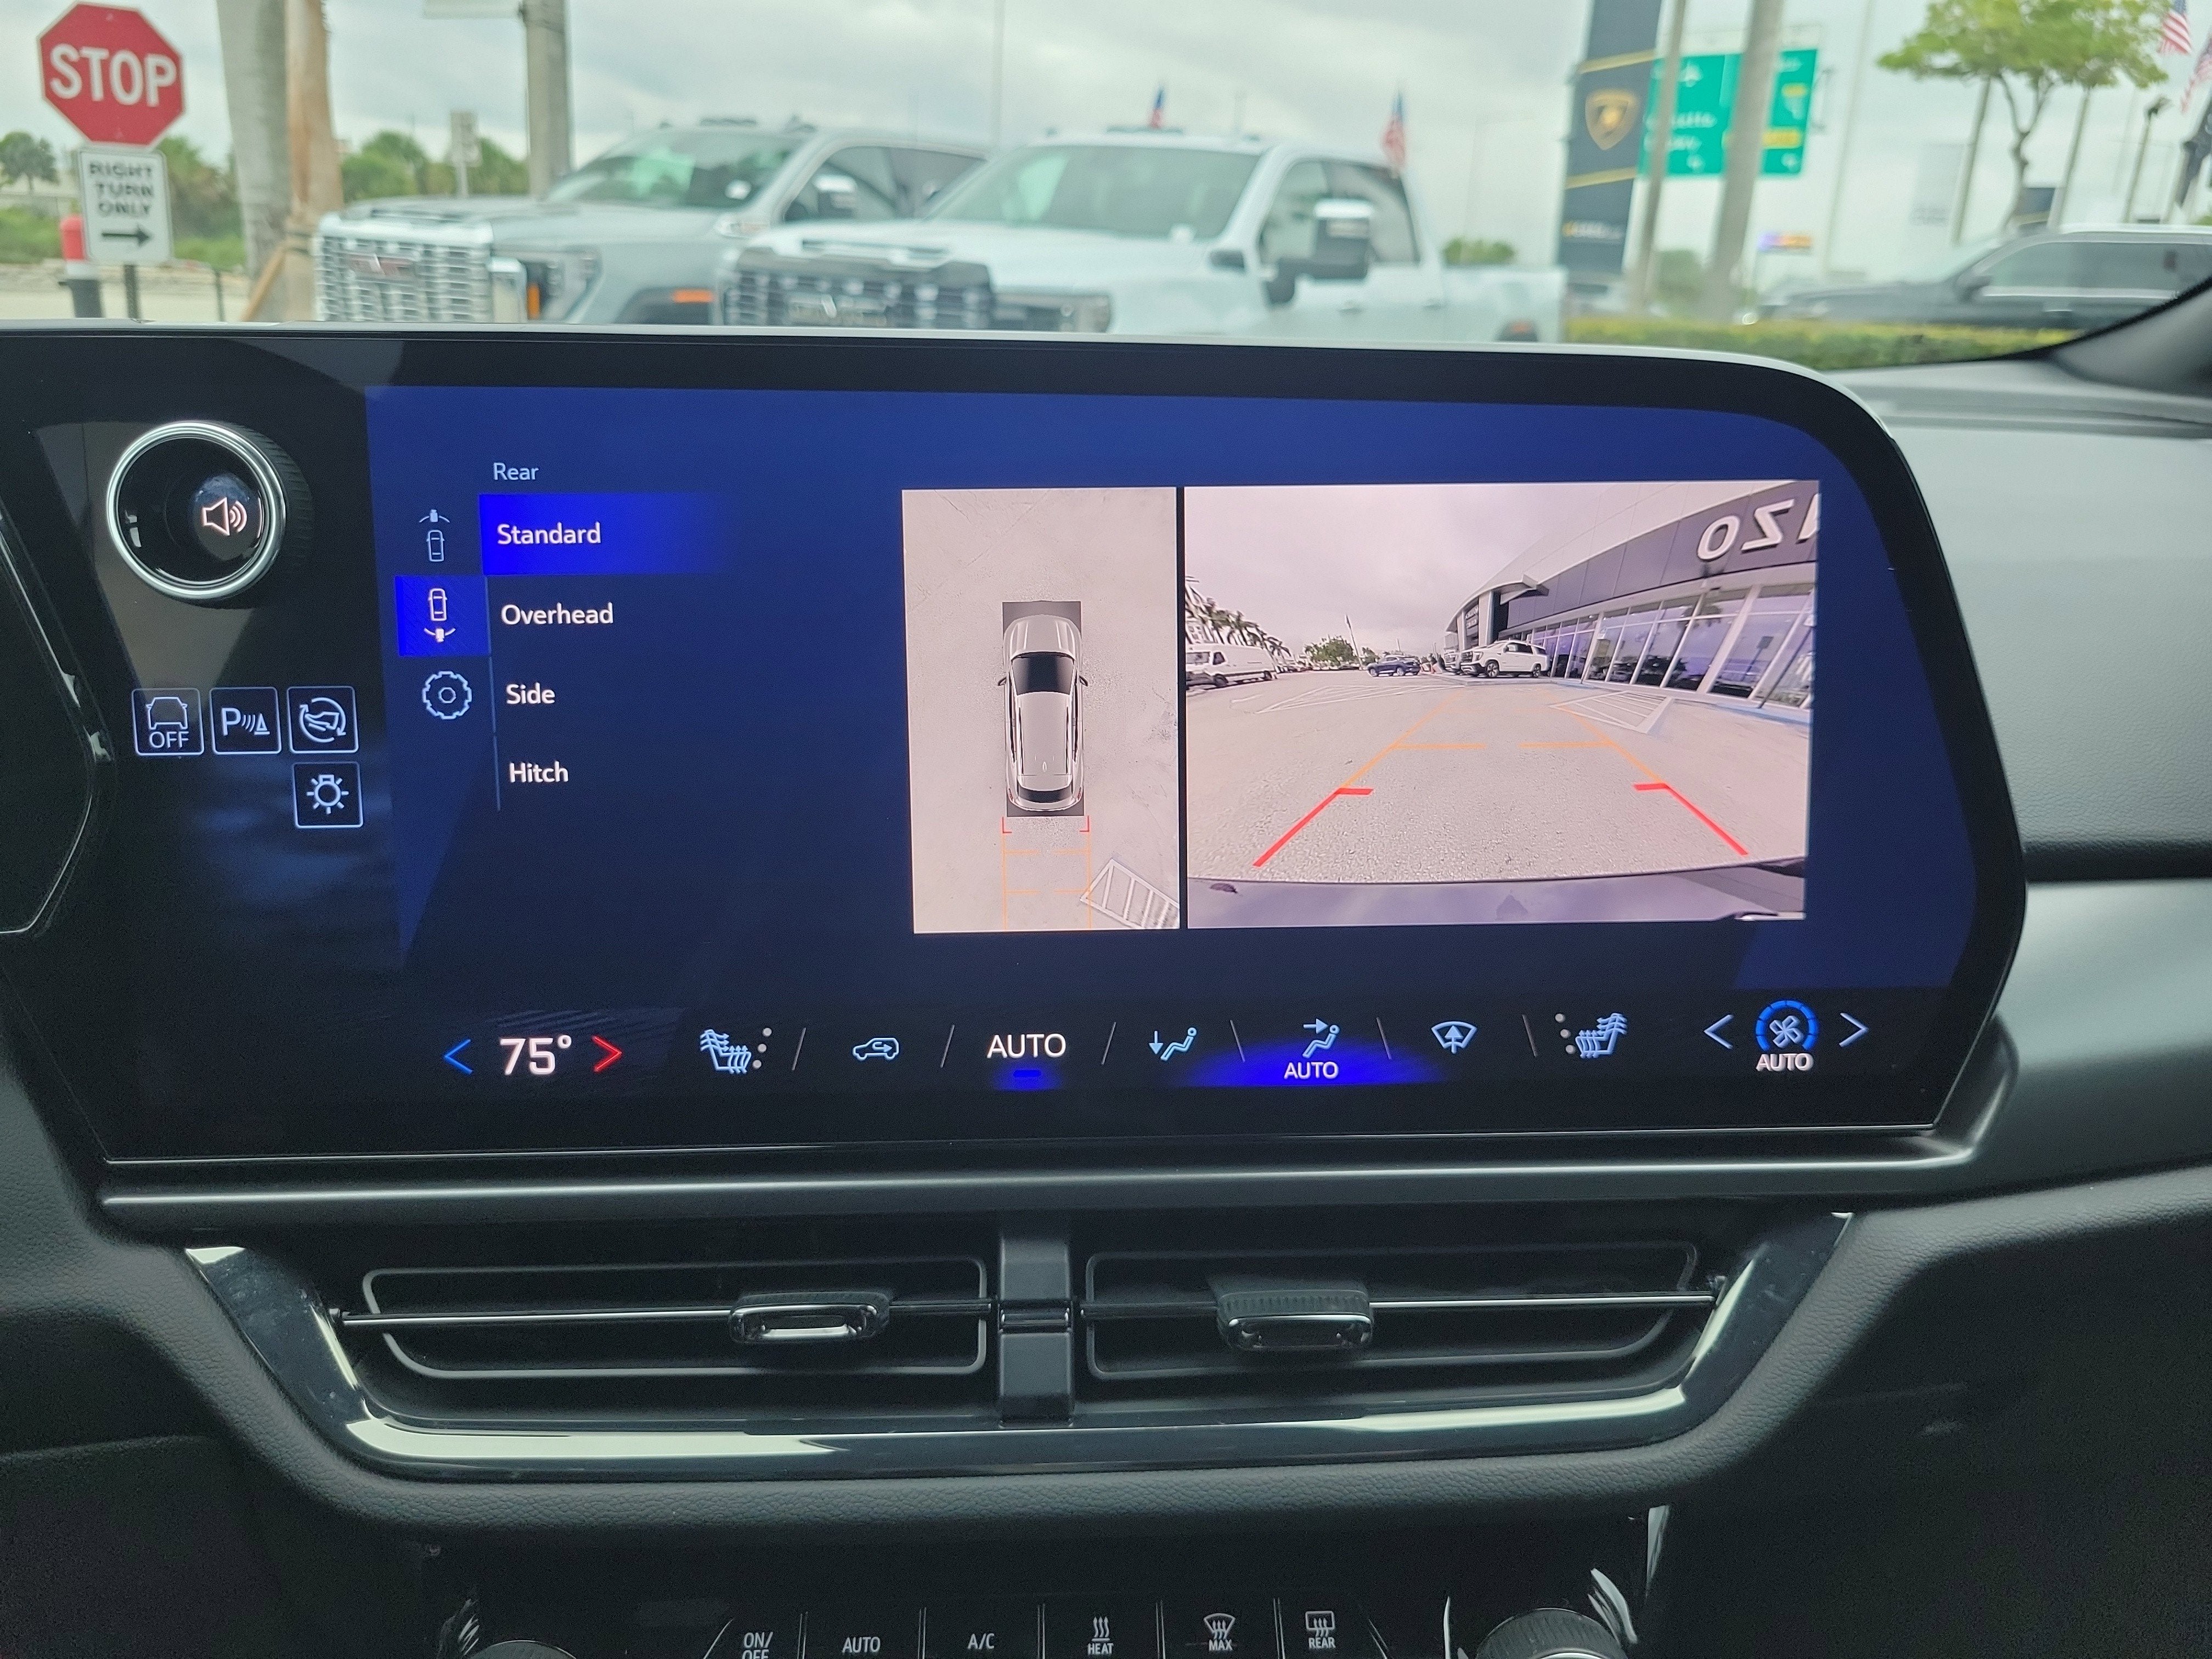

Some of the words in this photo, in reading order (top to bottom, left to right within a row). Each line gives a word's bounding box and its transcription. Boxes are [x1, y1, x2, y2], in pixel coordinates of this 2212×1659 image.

[49, 43, 177, 108] STOP
[89, 161, 153, 177] RIGHT
[95, 181, 154, 198] TURN
[98, 201, 153, 216] ONLY
[493, 462, 539, 481] Rear
[496, 522, 601, 545] Standard
[500, 602, 614, 625] Overhead
[506, 682, 556, 705] Side
[149, 731, 190, 748] OFF
[509, 760, 569, 784] Hitch
[986, 1032, 1066, 1059] AUTO
[500, 1034, 572, 1076] 75°
[1756, 1053, 1813, 1071] AUTO
[1284, 1061, 1339, 1079] AUTO
[743, 1632, 774, 1649] ON/
[842, 1637, 881, 1653] AUTO
[967, 1633, 995, 1650] A/C
[1209, 1639, 1233, 1651] MAX
[1308, 1637, 1336, 1649] REAR
[1087, 1643, 1114, 1656] HEAT
